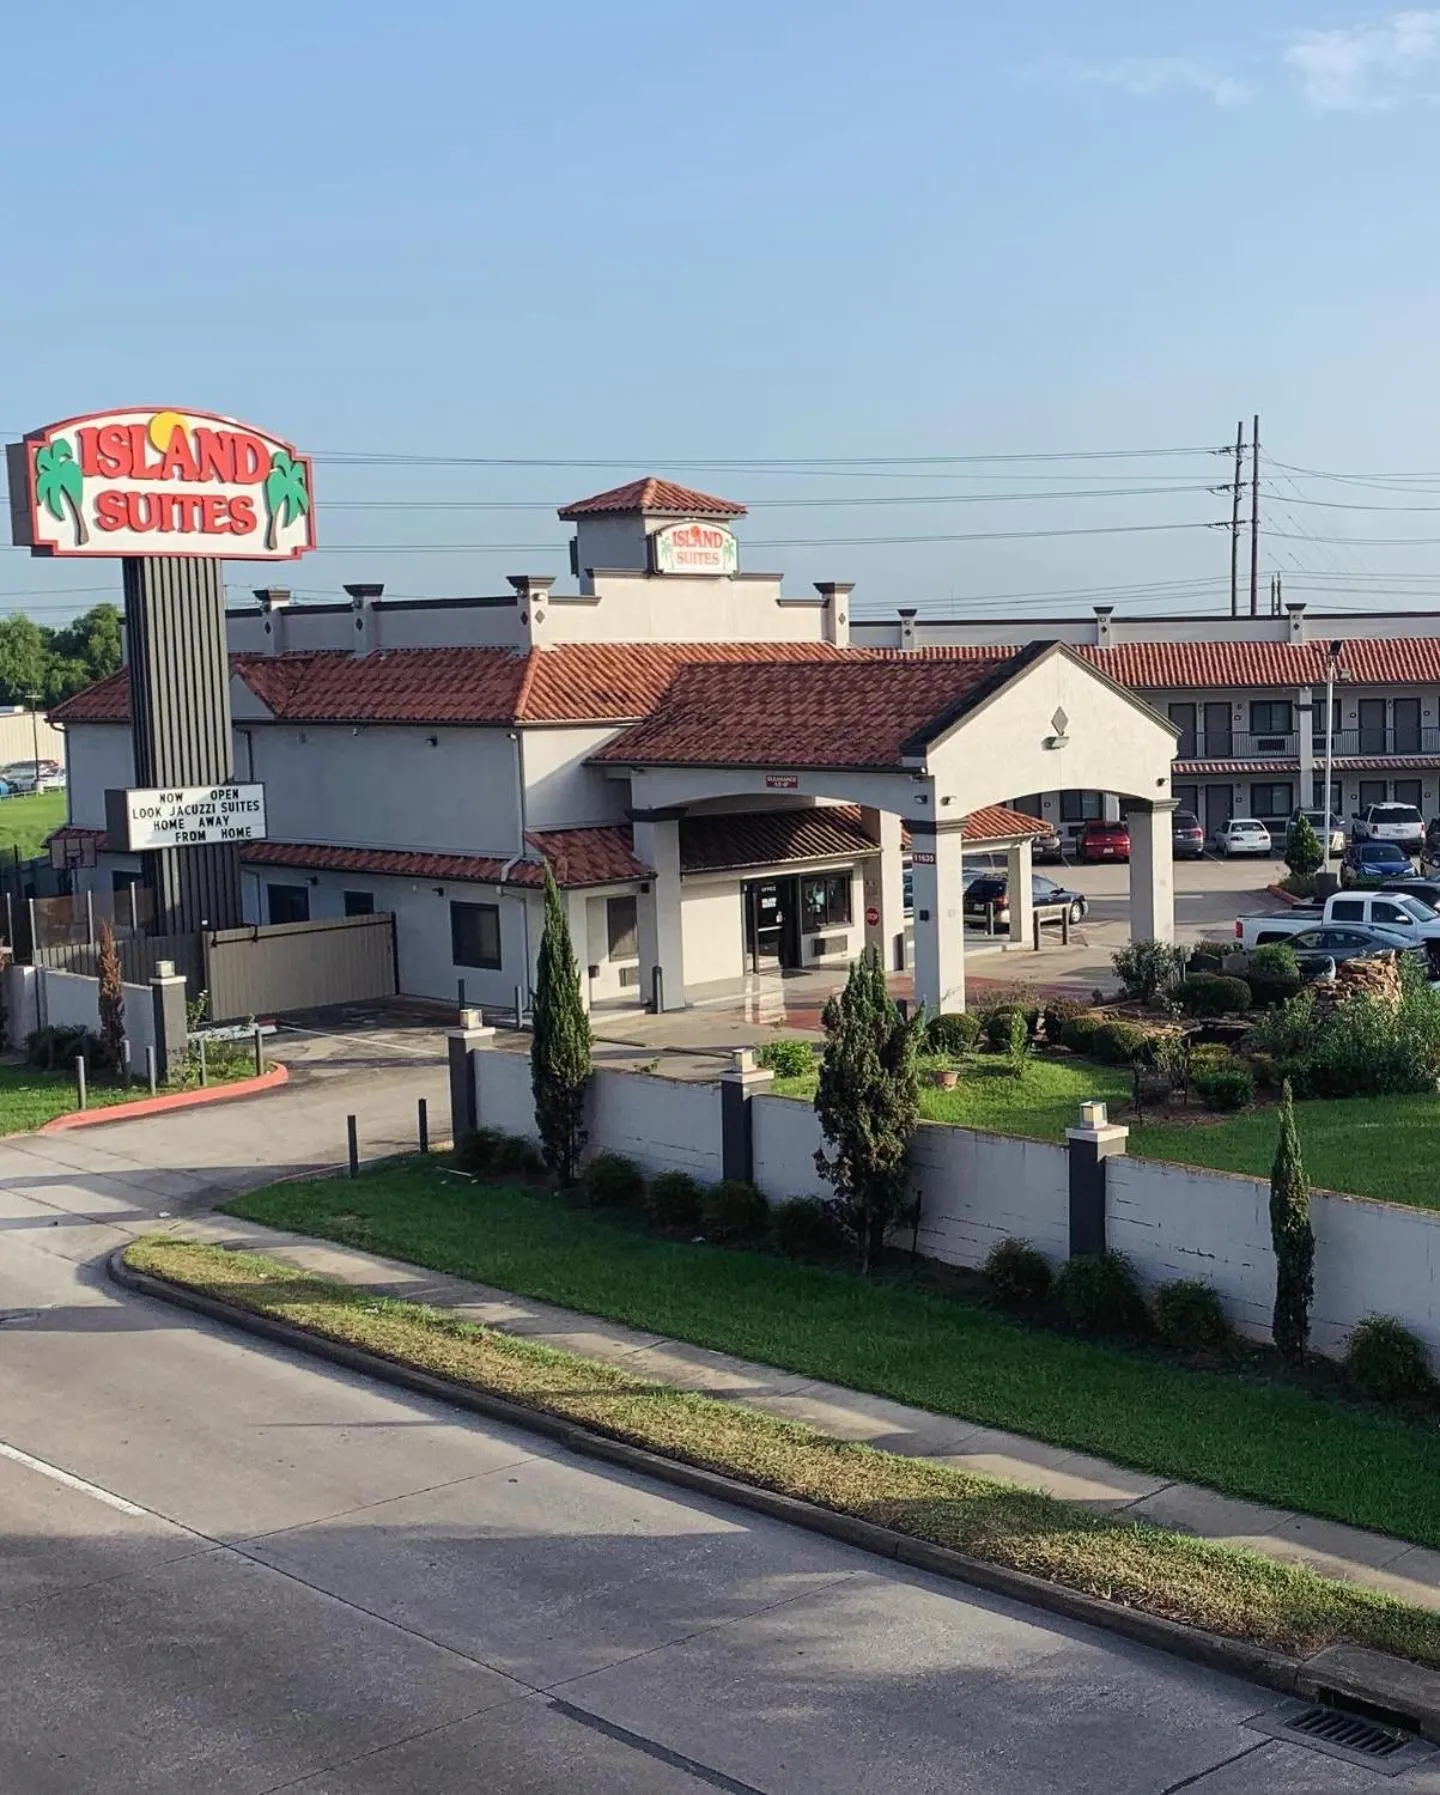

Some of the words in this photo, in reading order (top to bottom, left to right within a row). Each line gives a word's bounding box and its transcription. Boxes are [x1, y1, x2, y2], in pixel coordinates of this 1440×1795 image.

[77, 423, 270, 485] ISLAND
[94, 489, 258, 535] SUITES
[671, 525, 723, 548] ISLAND
[675, 551, 720, 565] SUITES
[159, 792, 184, 804] NOW
[210, 788, 239, 801] OPEN
[132, 806, 162, 820] LOOK
[169, 803, 216, 817] JACUZZI
[221, 800, 260, 813] SUITES
[153, 818, 185, 831] HOME
[199, 815, 230, 828] AWAY
[175, 830, 206, 843] FROM
[221, 826, 252, 840] HOME
